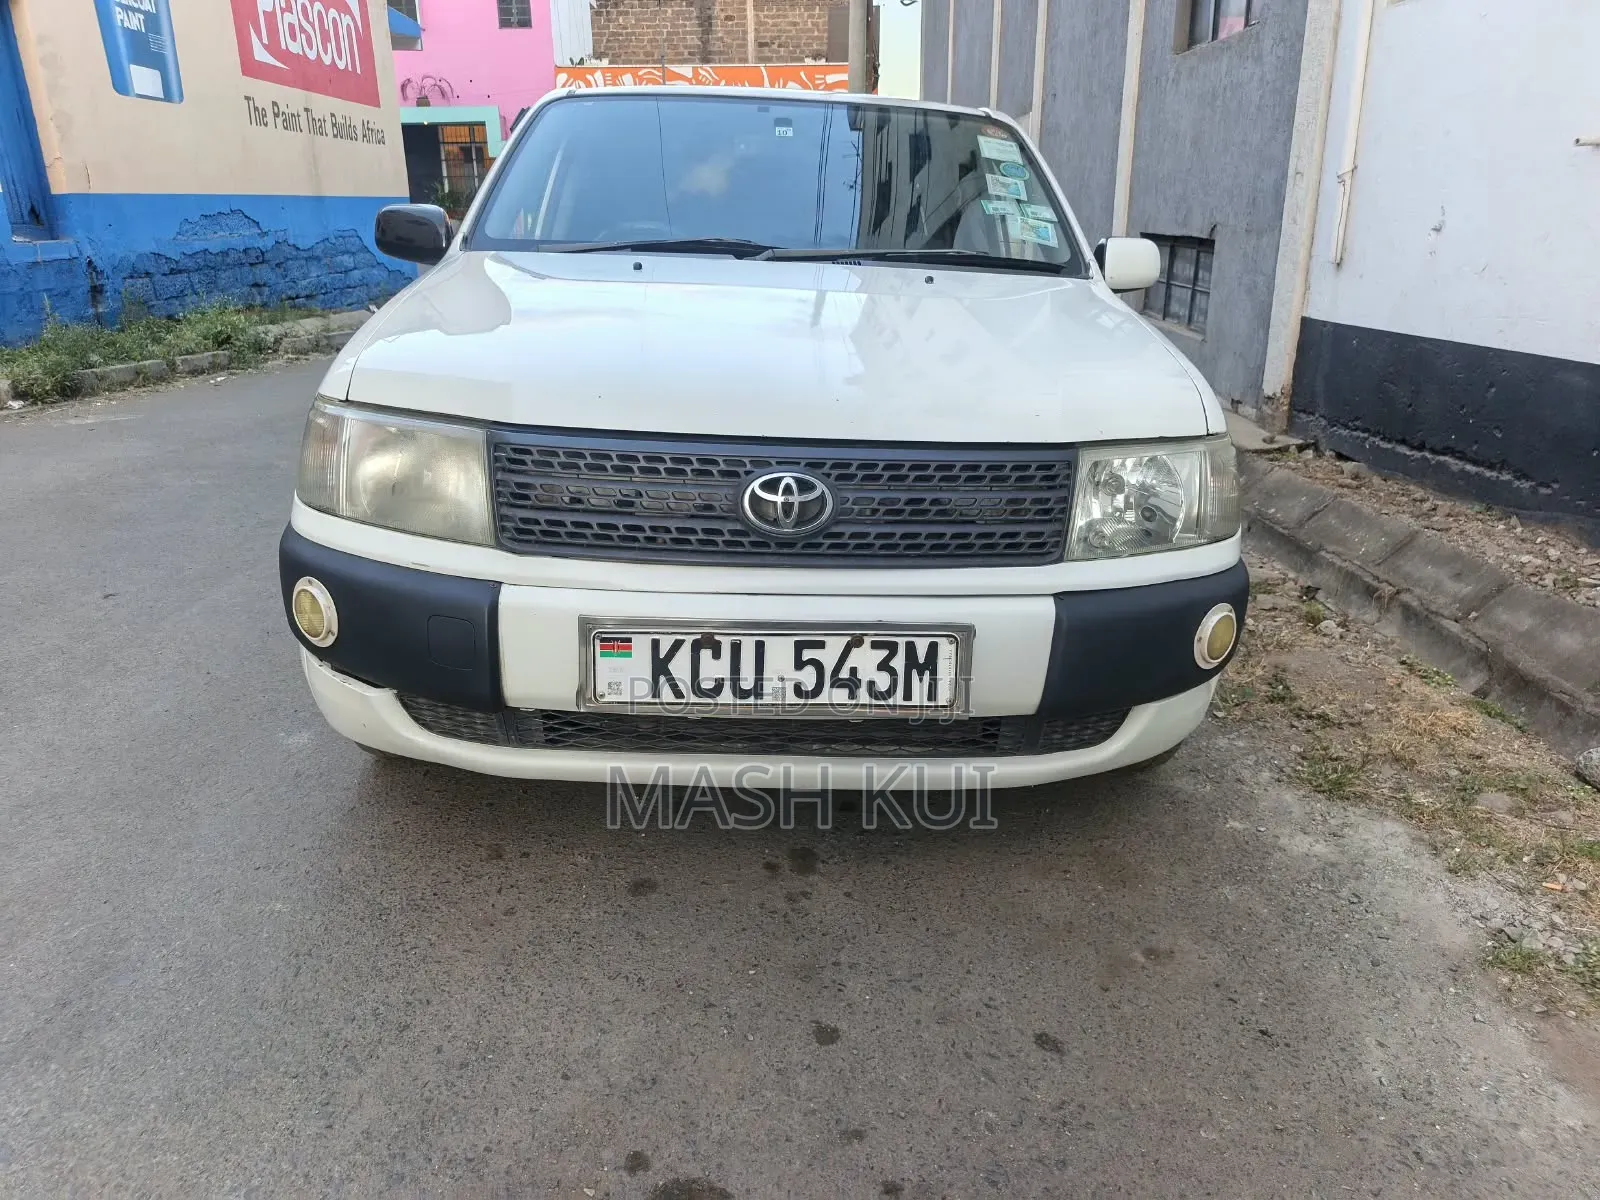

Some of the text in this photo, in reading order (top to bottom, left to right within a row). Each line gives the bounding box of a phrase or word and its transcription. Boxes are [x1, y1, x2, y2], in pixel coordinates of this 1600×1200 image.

[115, 6, 146, 33] PAINT
[244, 95, 386, 146] The Paint That Builds Africa
[650, 637, 766, 701] KCU
[793, 639, 939, 702] 543M
